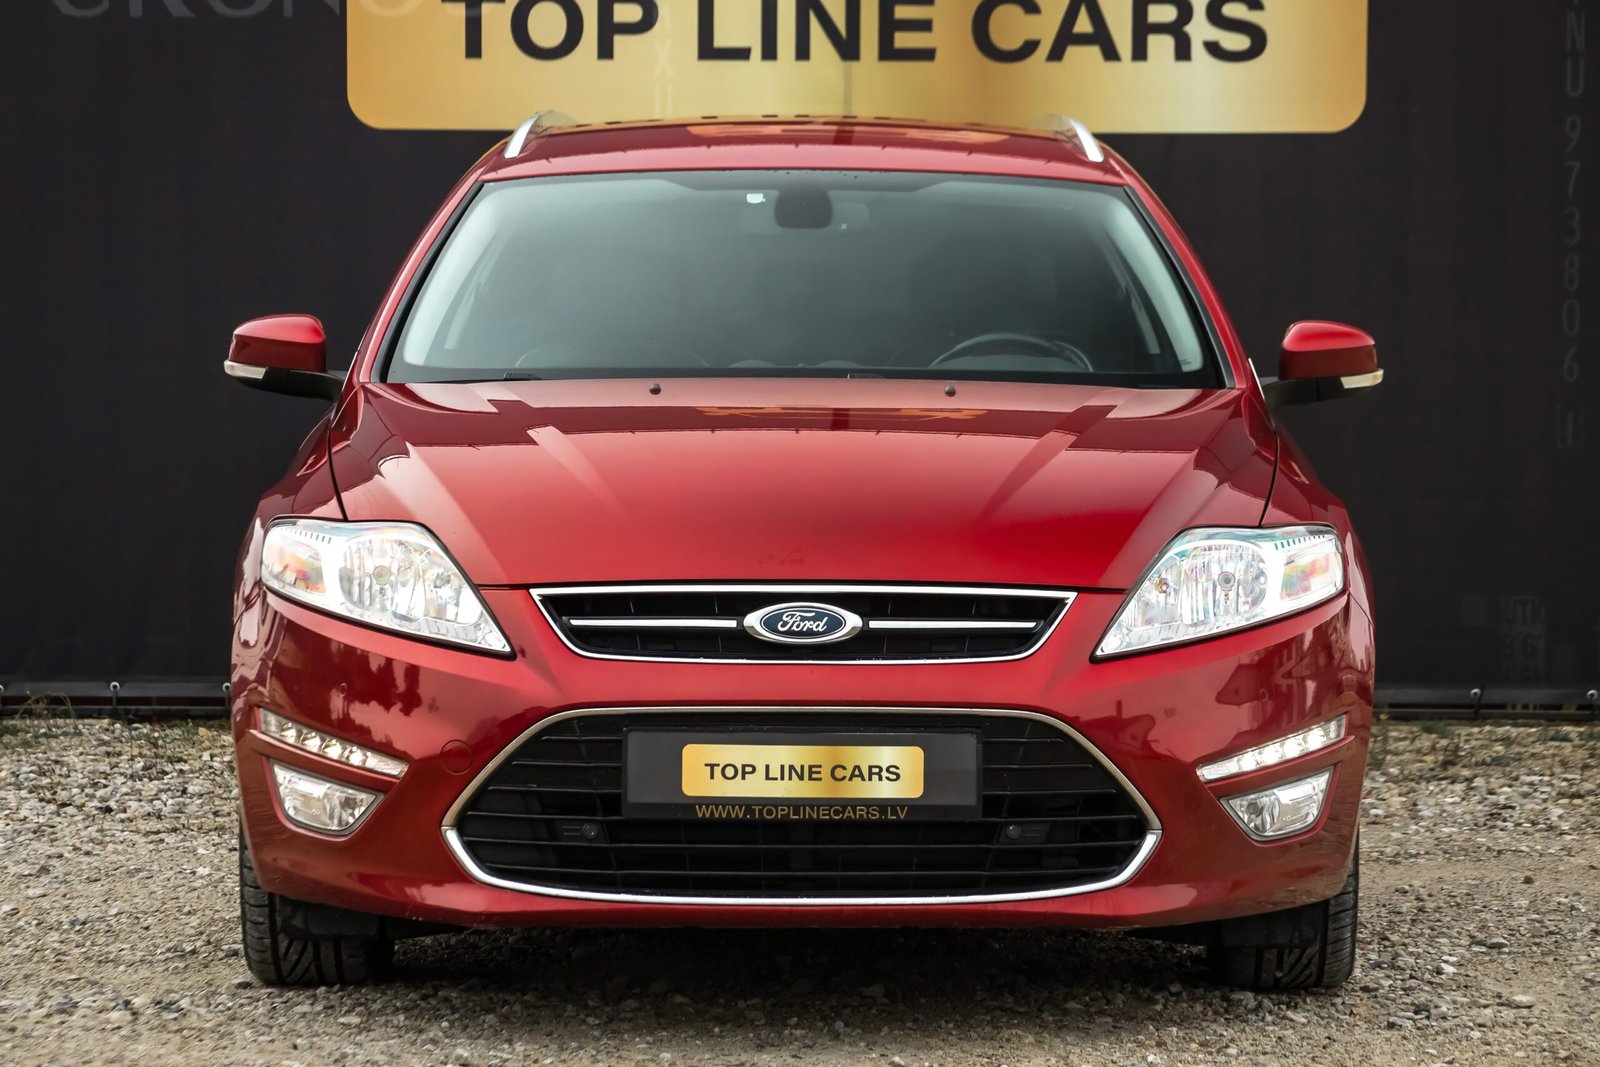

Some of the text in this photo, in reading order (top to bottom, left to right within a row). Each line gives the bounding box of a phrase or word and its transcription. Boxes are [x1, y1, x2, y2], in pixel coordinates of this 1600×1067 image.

[441, 0, 1268, 63] TOP LINE CARS
[1565, 0, 1586, 97] NU
[1562, 114, 1582, 382] 973806
[777, 611, 829, 632] Ford
[704, 763, 901, 783] TOP LINE CARS
[695, 804, 909, 820] WWW.TOPLINECARS.LV
